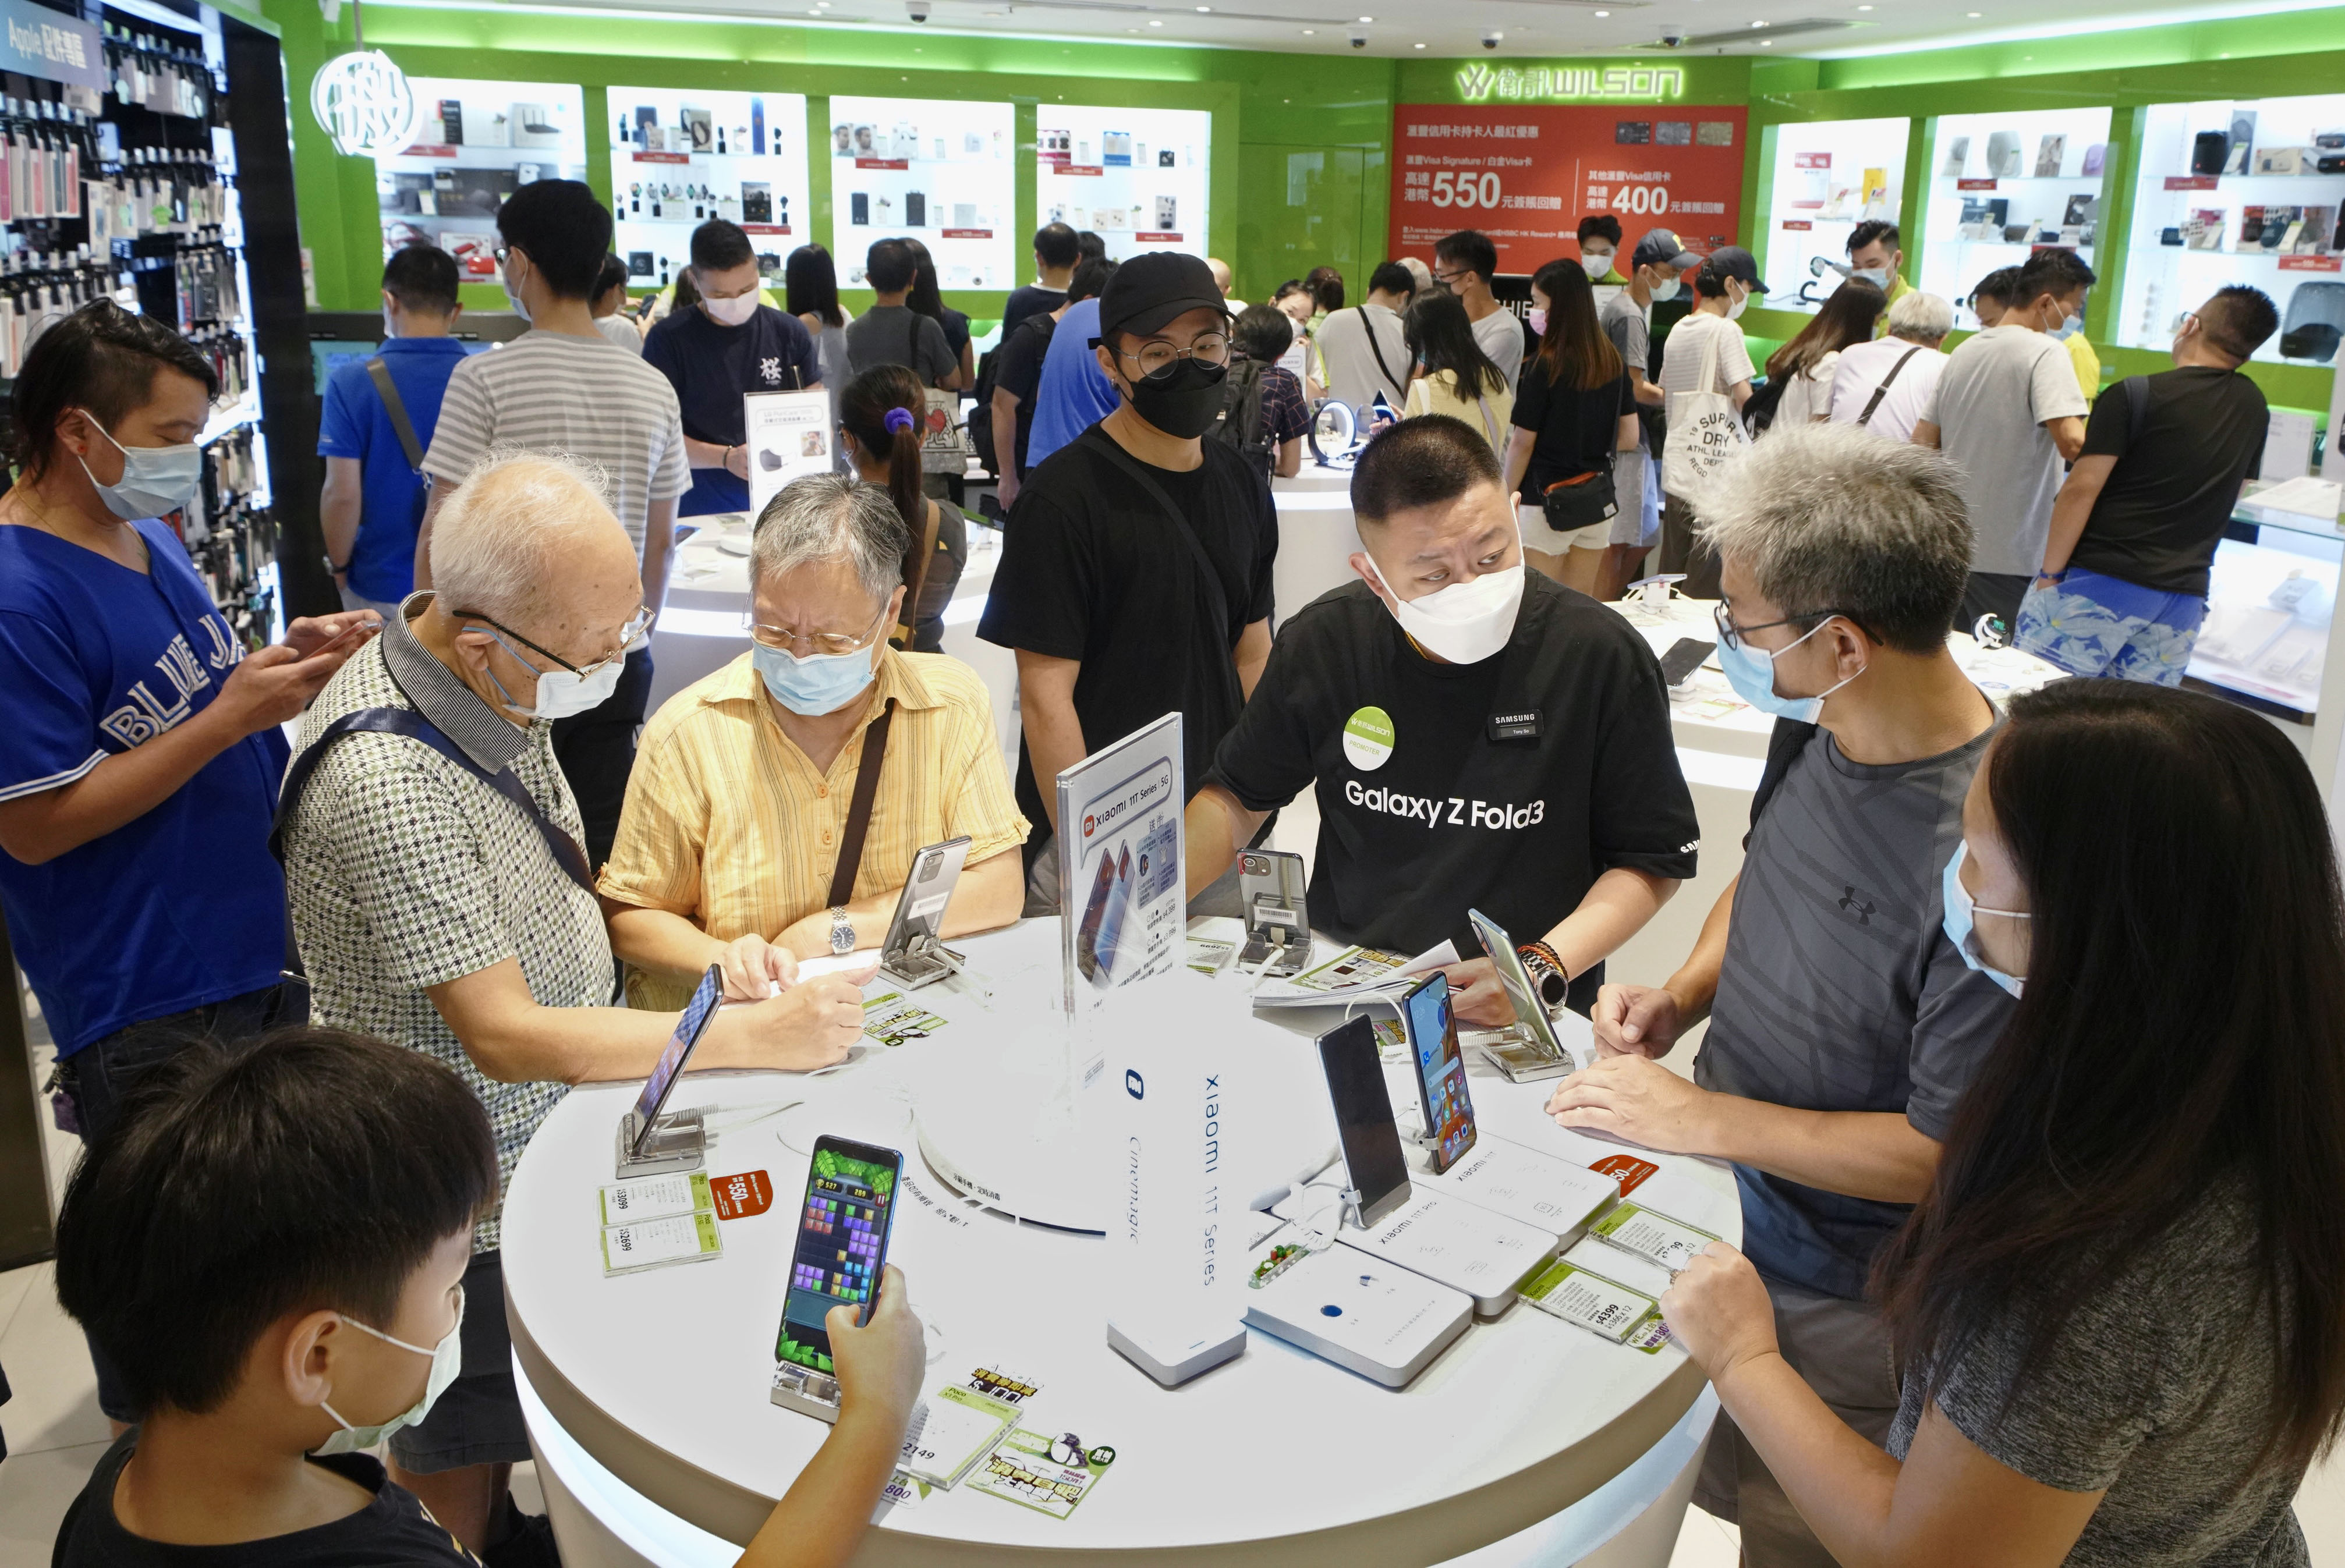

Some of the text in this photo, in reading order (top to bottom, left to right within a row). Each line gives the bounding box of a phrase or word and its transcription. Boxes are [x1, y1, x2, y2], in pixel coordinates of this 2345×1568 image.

[8, 17, 42, 61] Apple
[1405, 171, 1430, 186] 高達
[1404, 187, 1429, 202] 港幣
[1432, 171, 1501, 209] 550
[1611, 186, 1669, 215] 400
[1703, 431, 1730, 448] DRY
[99, 633, 211, 750] BLUE
[1495, 713, 1535, 724] SAMSUNG
[1349, 740, 1380, 755] PROMOTER
[1129, 792, 1139, 806] 11T
[1140, 782, 1157, 800] Series
[1161, 775, 1169, 787] 5G
[1345, 780, 1545, 830] Galaxy Z Fold3
[728, 1182, 749, 1201] 550
[825, 1182, 837, 1190] 527
[854, 1189, 866, 1197] 289
[617, 1190, 628, 1209] $3099
[1205, 1185, 1218, 1215] 11T
[620, 1230, 632, 1251] $2699
[1204, 1223, 1217, 1286] Series
[1528, 1284, 1545, 1297] Xiaomi
[1596, 1304, 1619, 1325] $4399
[948, 1387, 966, 1397] Poco
[884, 1484, 912, 1500] 800
